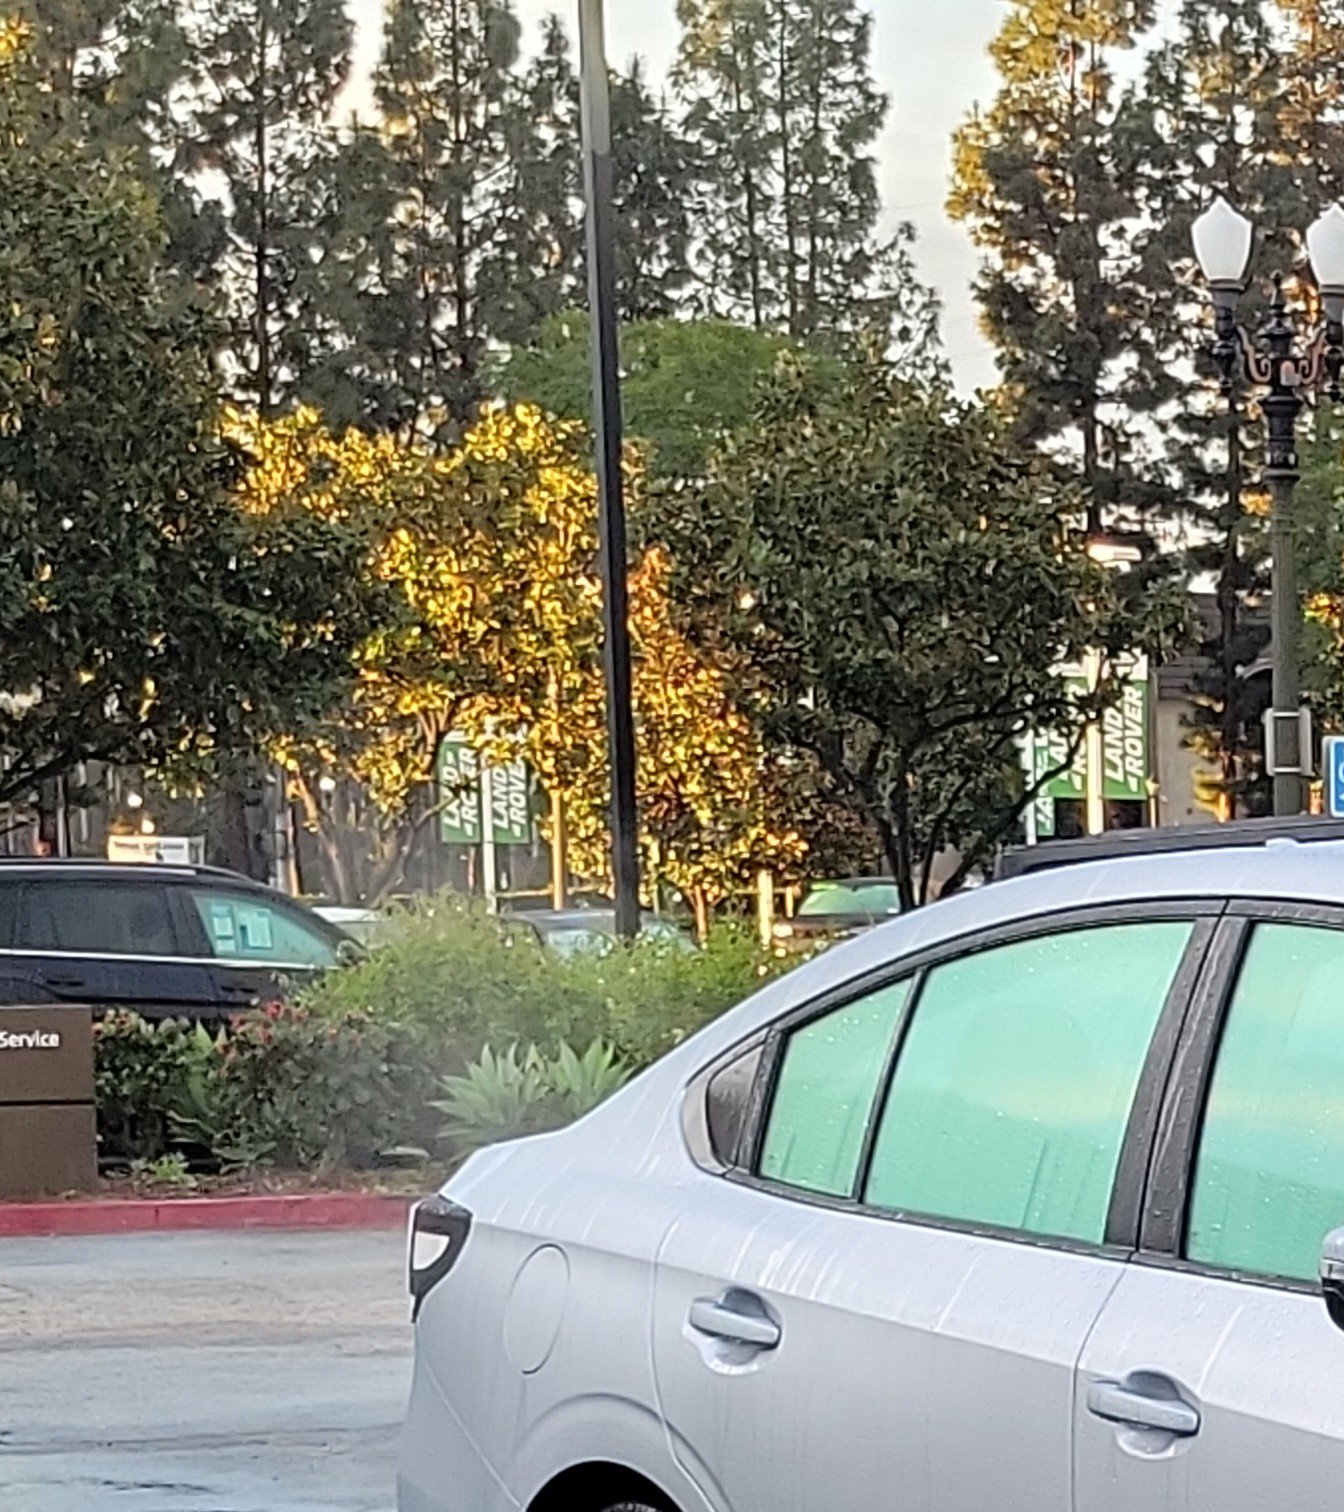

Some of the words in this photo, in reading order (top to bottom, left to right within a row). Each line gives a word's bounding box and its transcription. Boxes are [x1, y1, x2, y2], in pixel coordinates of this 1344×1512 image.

[1104, 706, 1124, 782] LAND
[1124, 686, 1144, 777] ROVER
[492, 766, 509, 829] LAND
[0, 1030, 60, 1048] Service
